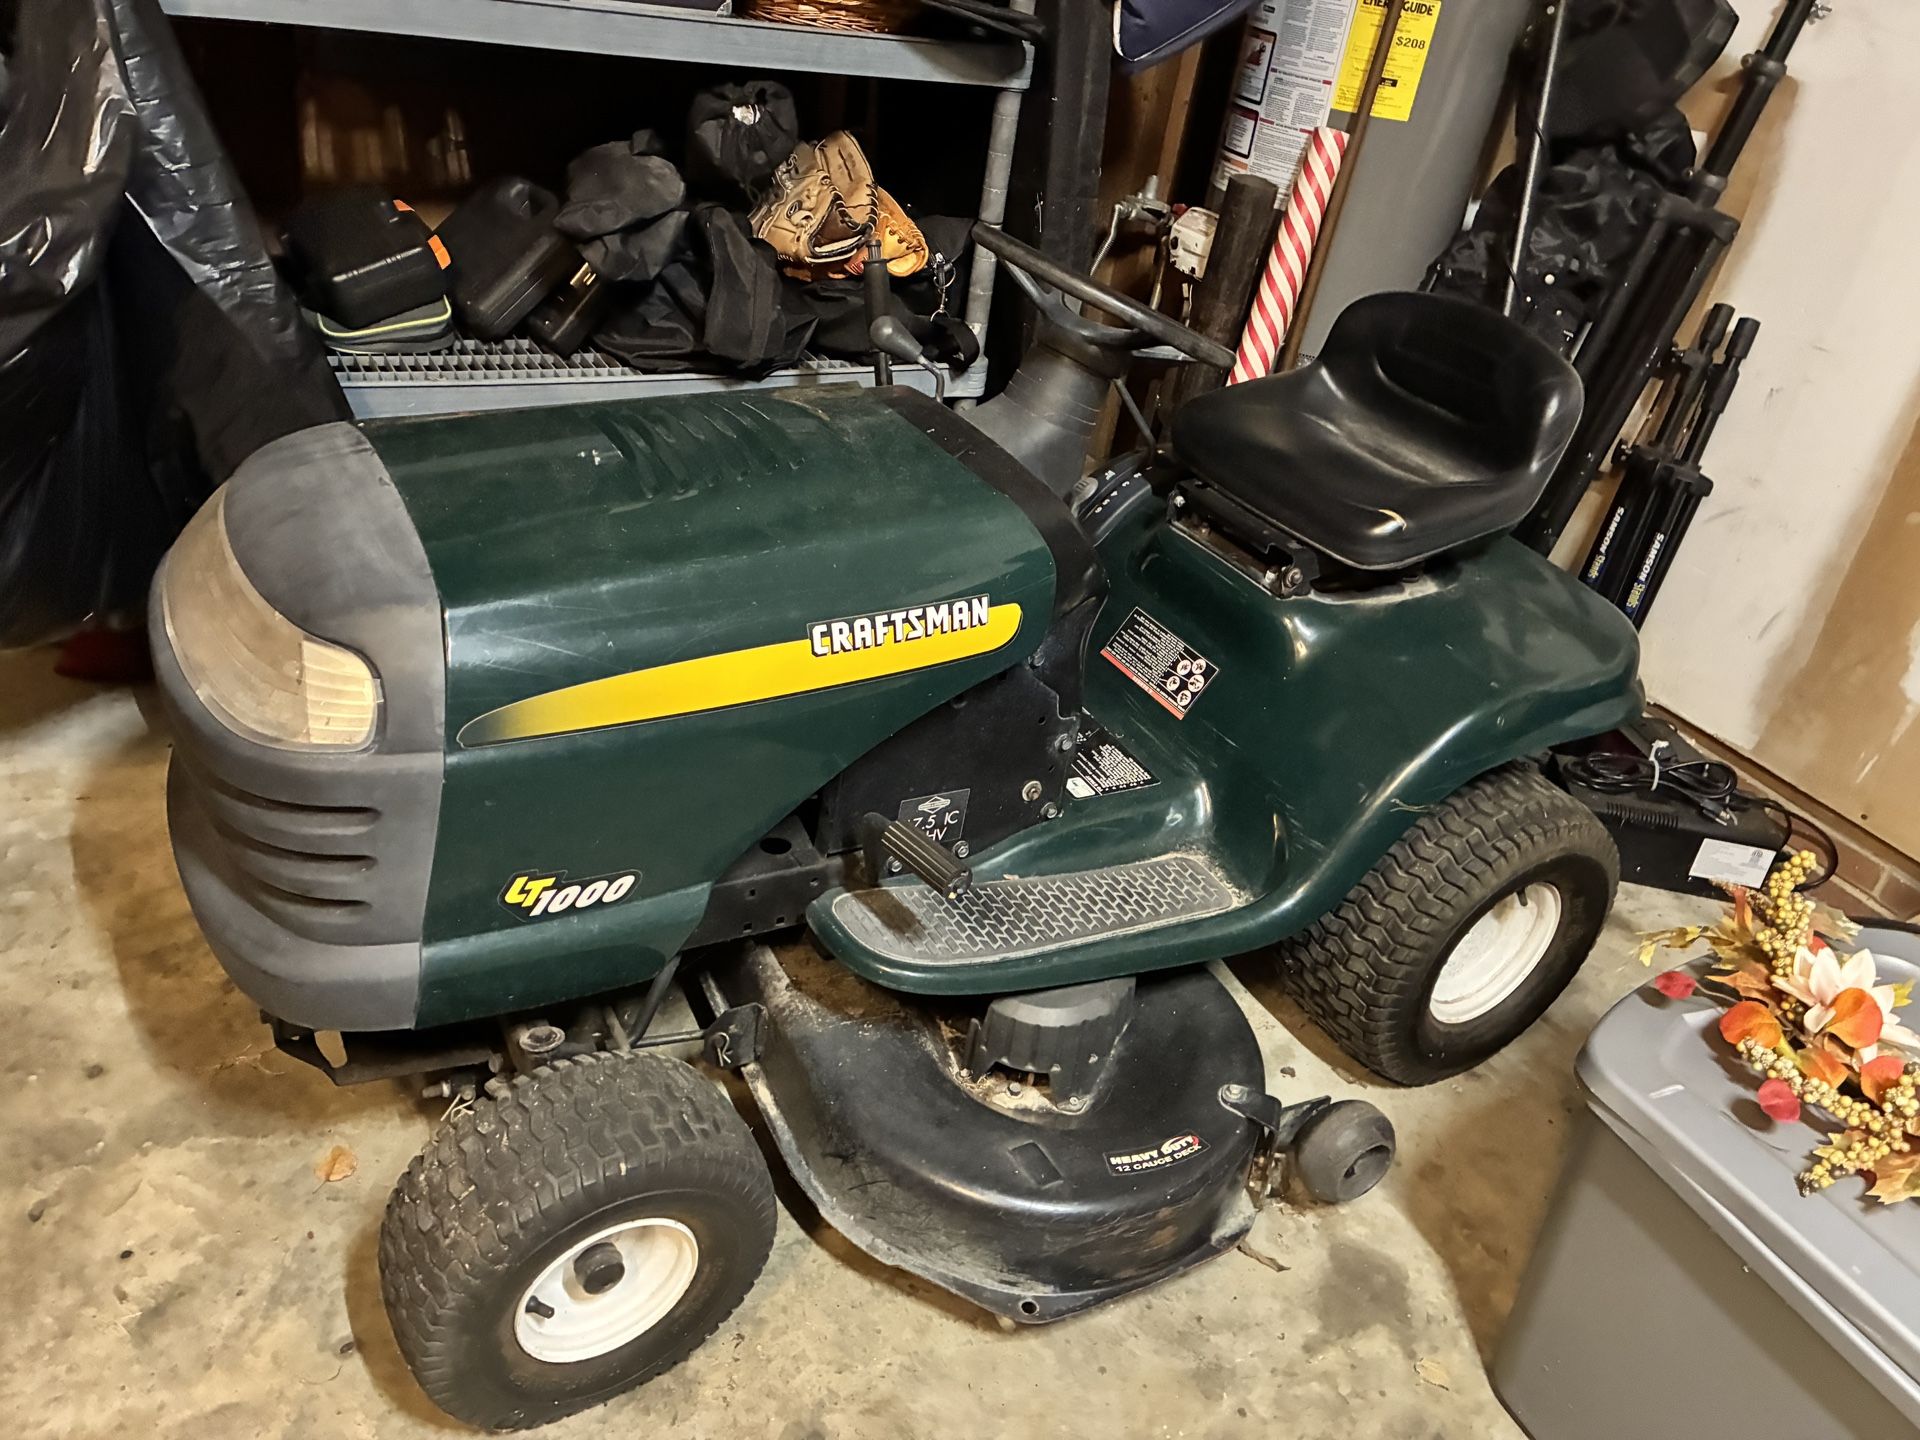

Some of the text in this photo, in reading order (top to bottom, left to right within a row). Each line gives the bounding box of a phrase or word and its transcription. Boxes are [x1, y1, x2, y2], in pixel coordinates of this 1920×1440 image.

[1395, 36, 1426, 50] $208
[1599, 506, 1625, 554] SAMSON
[1638, 531, 1665, 582] SAMSON
[811, 597, 989, 657] CRAFTSMAN
[1109, 1149, 1159, 1166] HEAVY
[1115, 1165, 1132, 1173] 12
